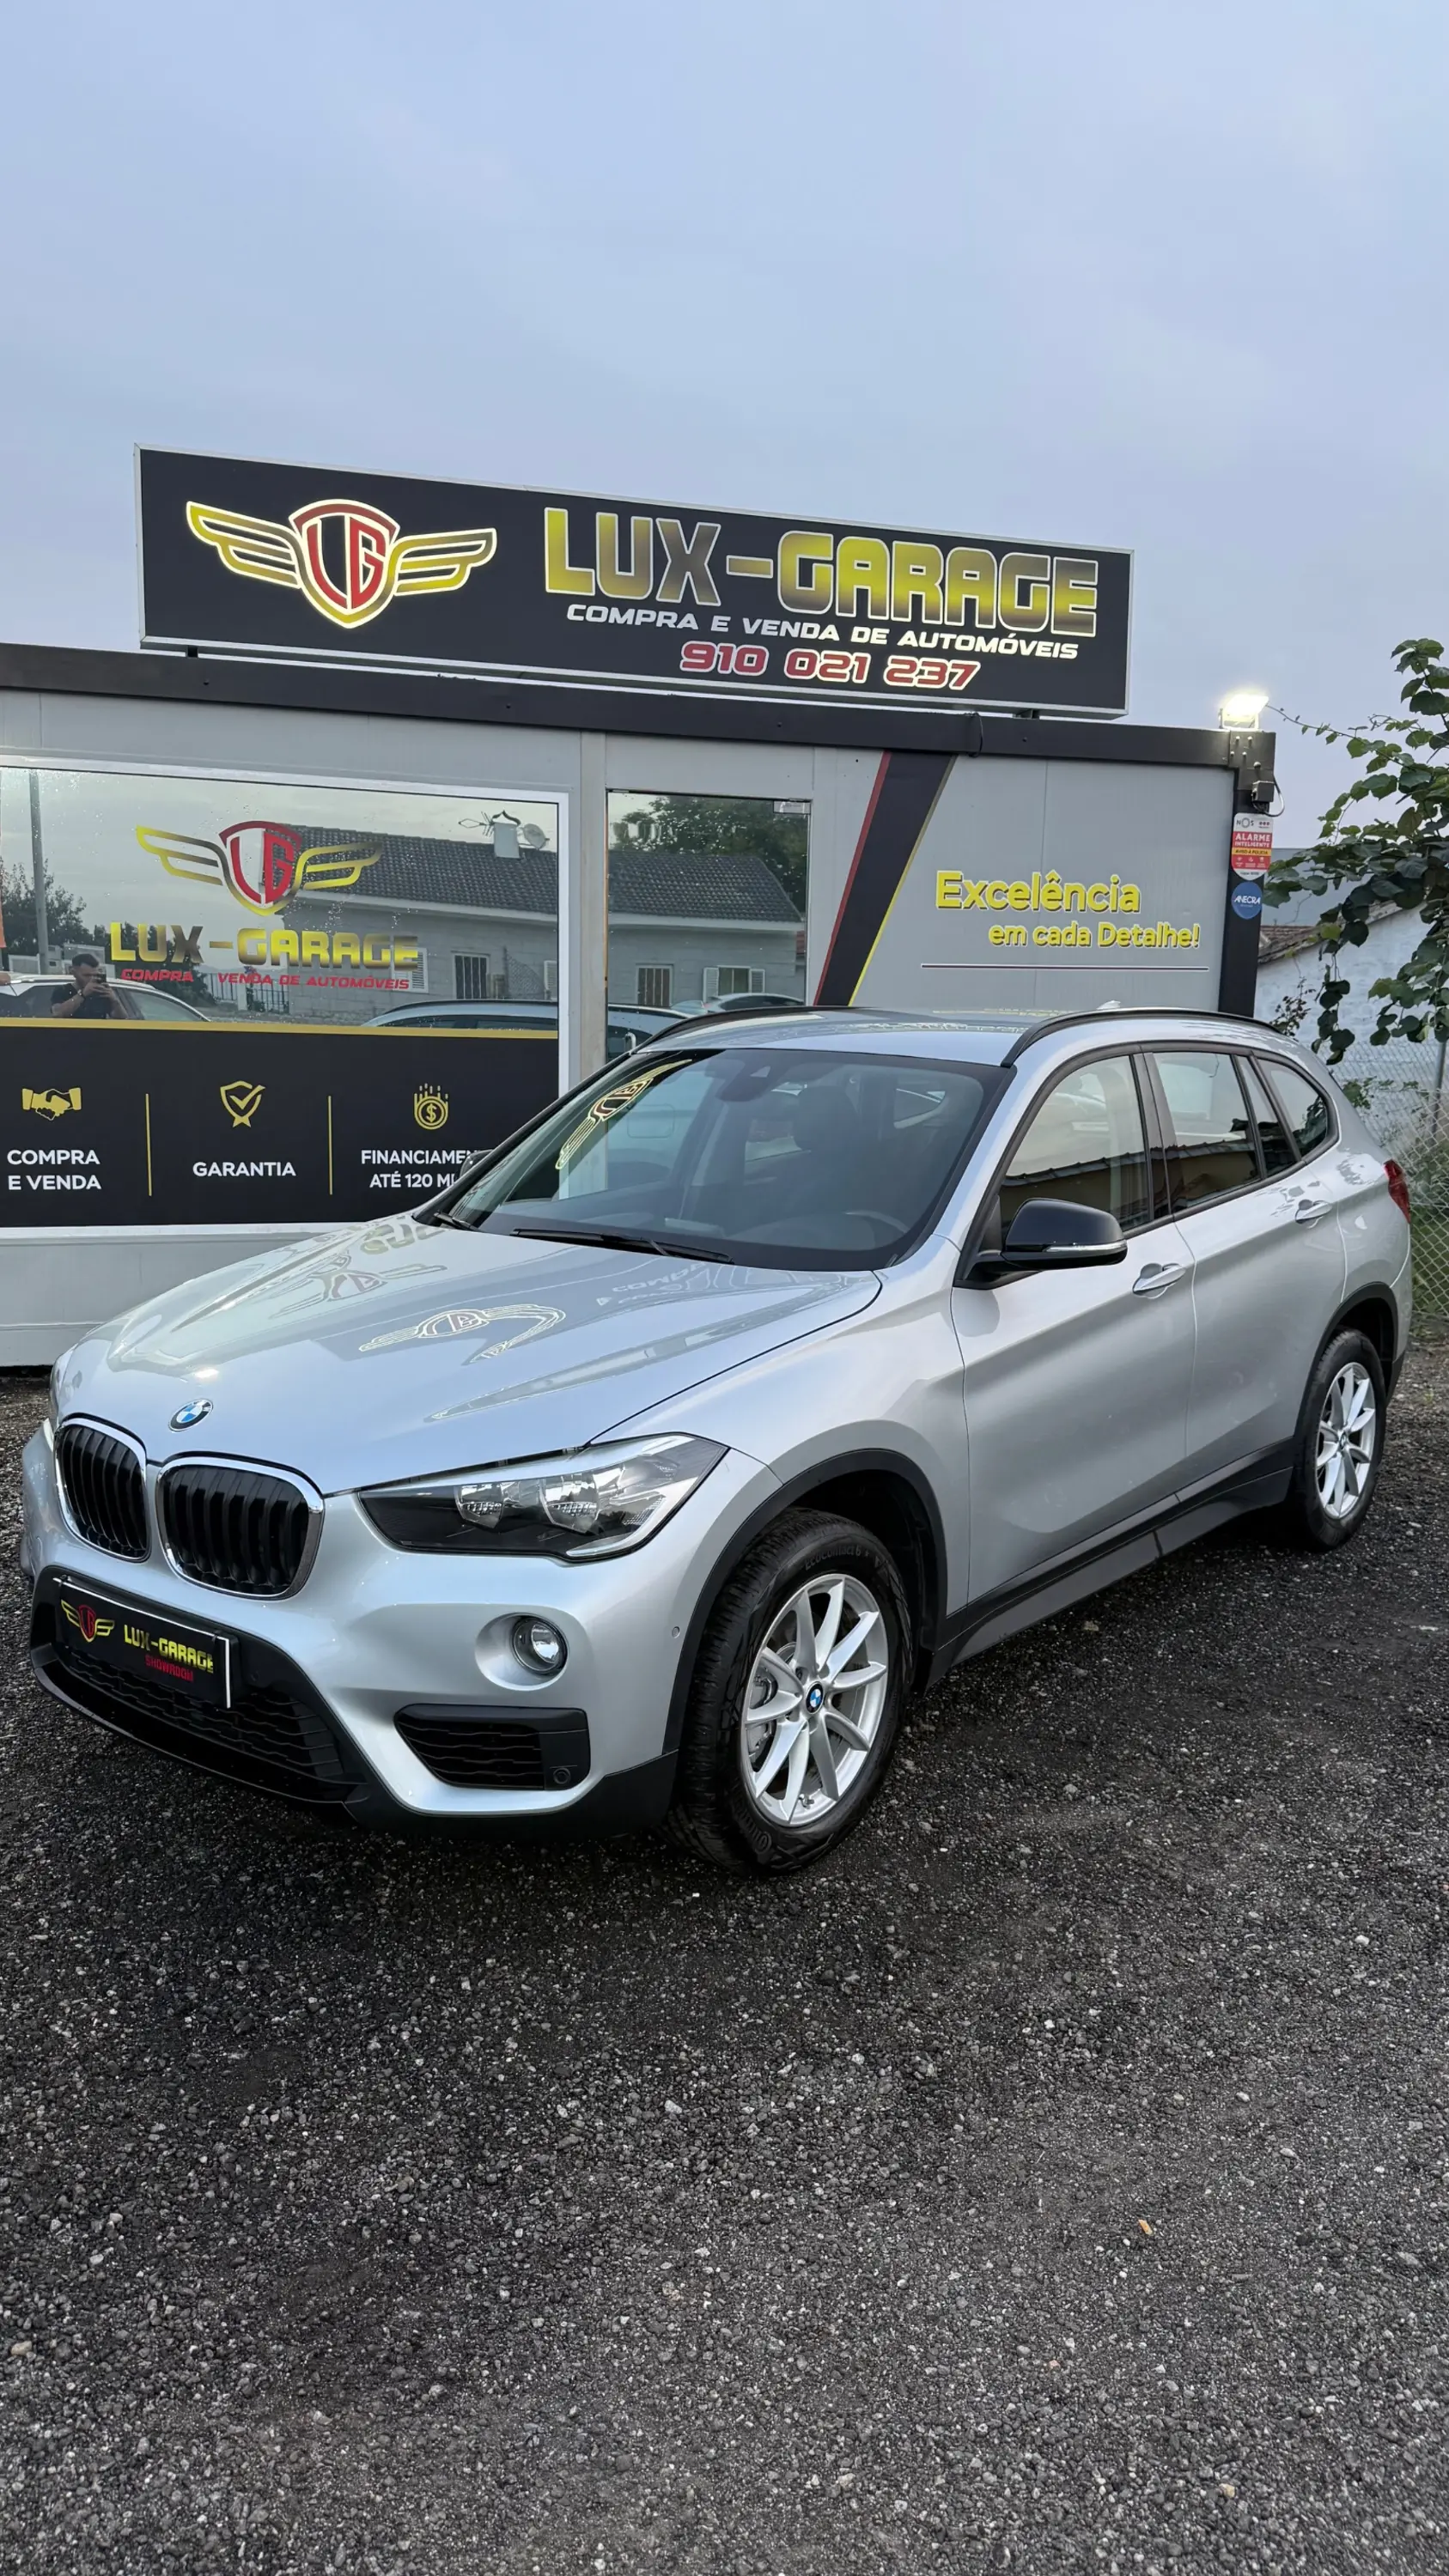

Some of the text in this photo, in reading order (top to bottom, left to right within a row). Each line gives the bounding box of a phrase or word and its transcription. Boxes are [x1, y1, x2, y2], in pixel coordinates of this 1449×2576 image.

[544, 507, 1099, 637] LUX-GARAGE
[566, 604, 1079, 660] COMPRA E VENDA DE AUTOMÓVEIS
[679, 641, 981, 690] 910 021 237
[1236, 817, 1254, 829] NOS
[1235, 832, 1271, 842] ALARME
[935, 869, 1142, 914] Excelência
[1234, 895, 1261, 905] ANECRA
[989, 920, 1201, 950] em cada Detalhe!
[120, 969, 410, 990] COMPRA VENDA DE AUTOMÓVEIS
[7, 1149, 100, 1166] COMPRA
[361, 1149, 481, 1165] FINANCIAME
[192, 1162, 296, 1177] GARANTIA
[369, 1170, 402, 1188] ATÉ
[405, 1173, 433, 1188] 120
[9, 1174, 101, 1191] E VENDA
[124, 1624, 214, 1674] LUX-GARAGE
[145, 1654, 193, 1681] SHOWROOM
